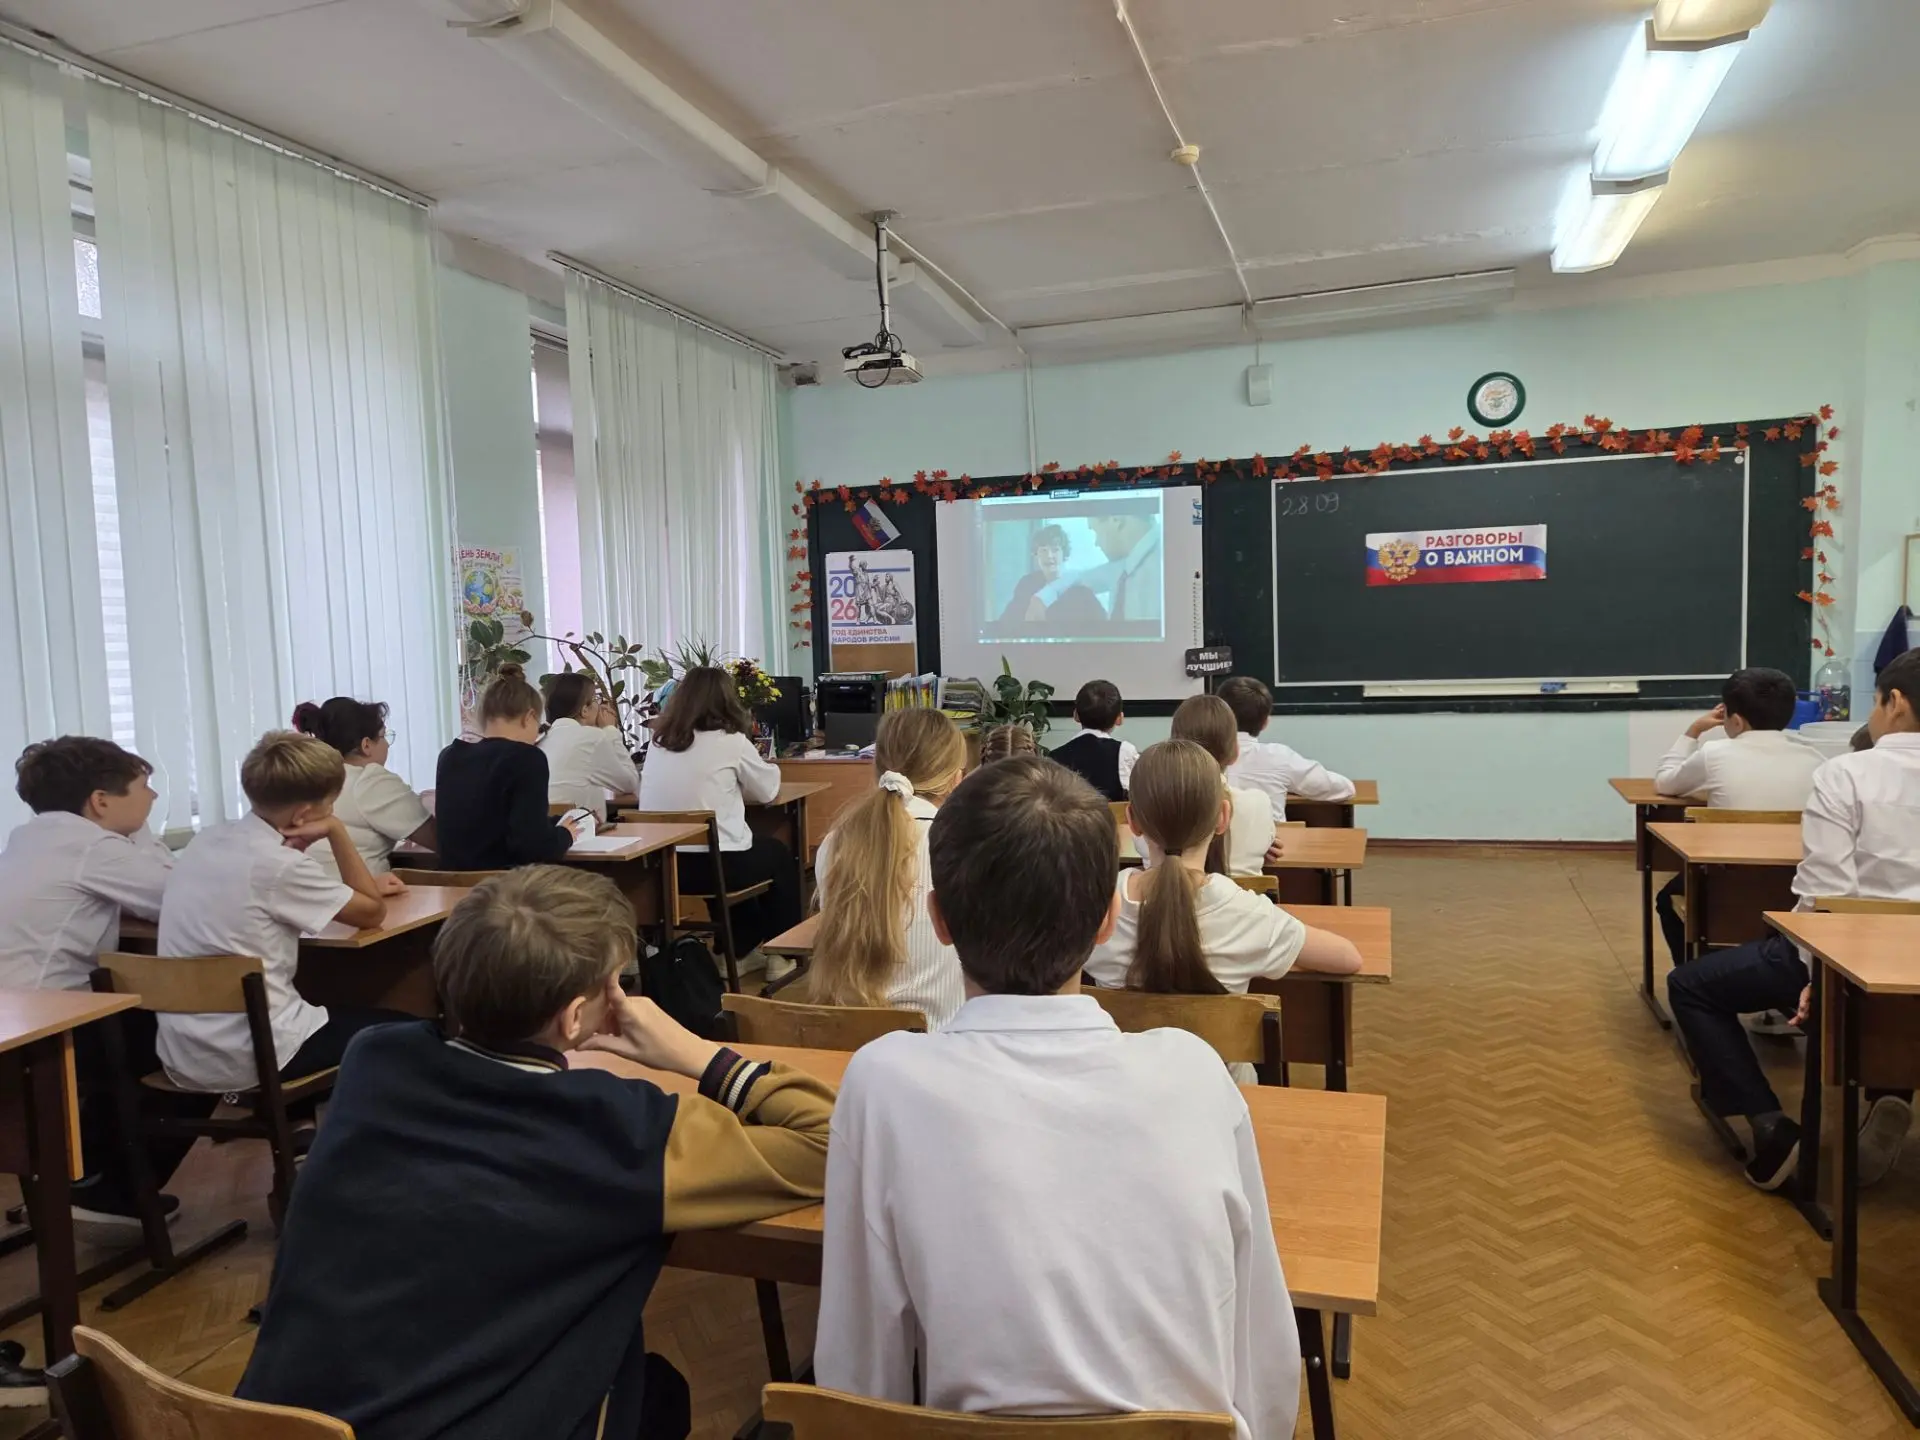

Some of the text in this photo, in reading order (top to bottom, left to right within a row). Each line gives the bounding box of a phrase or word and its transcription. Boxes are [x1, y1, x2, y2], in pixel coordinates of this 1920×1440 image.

[1425, 531, 1523, 548] РАЗГОВОРЫ
[1425, 548, 1523, 566] О ВАЖНОМ
[830, 576, 856, 598] 20
[831, 599, 857, 620] 26
[848, 628, 887, 636] ЕДИНСТВА
[1199, 652, 1219, 660] МЫ
